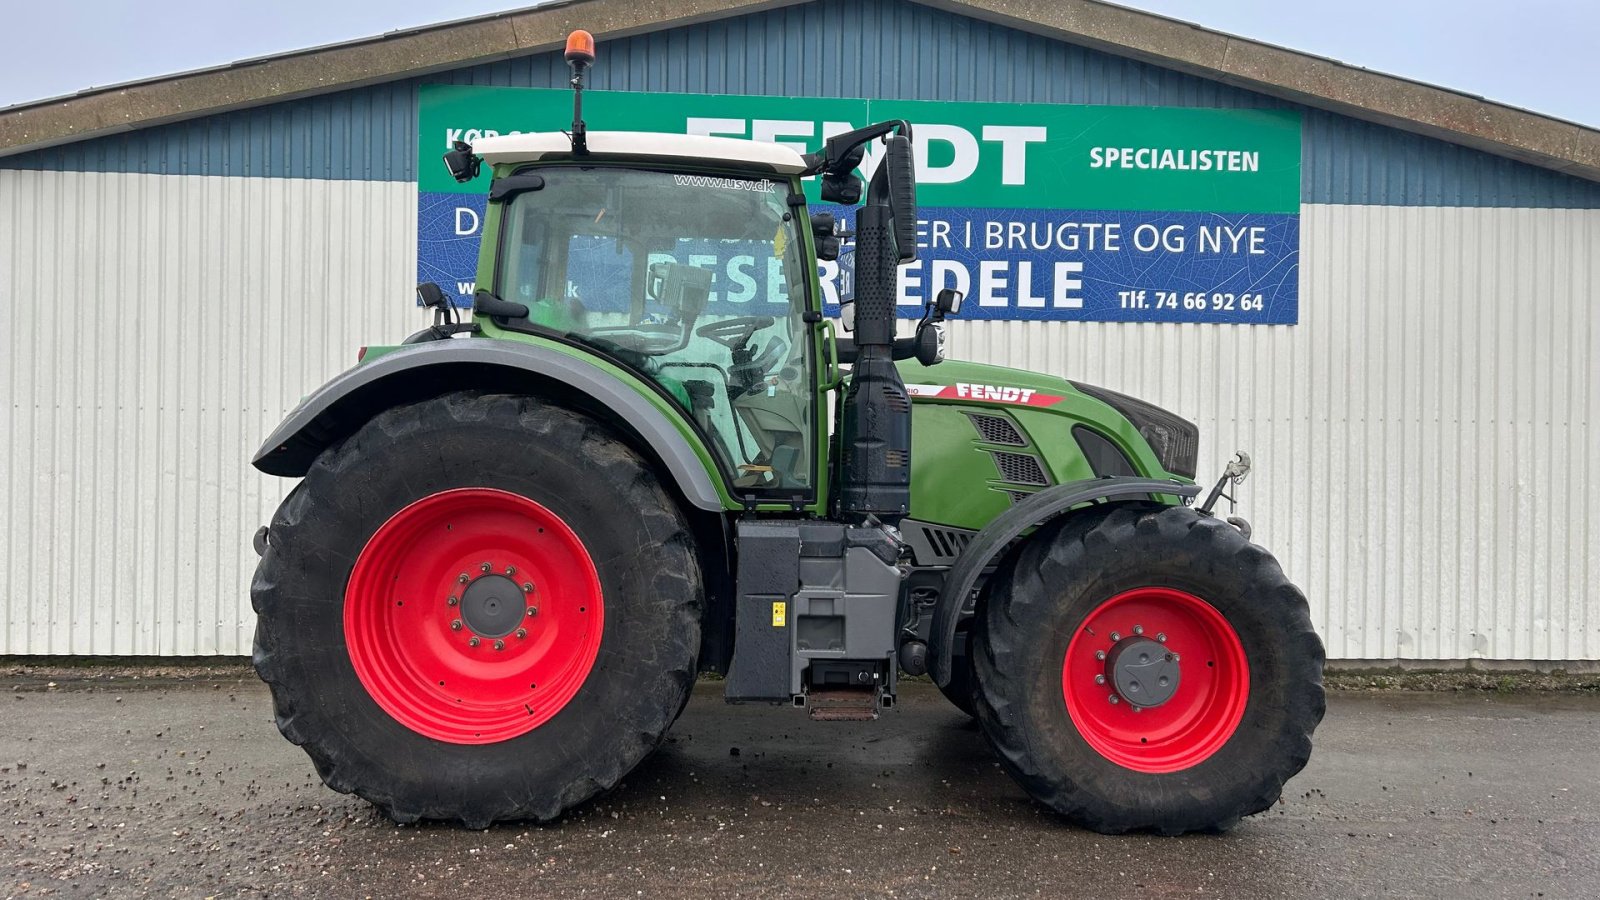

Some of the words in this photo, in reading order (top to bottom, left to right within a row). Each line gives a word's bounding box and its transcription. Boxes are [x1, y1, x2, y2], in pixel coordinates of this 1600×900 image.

[1090, 146, 1259, 172] SPECIALISTEN
[674, 174, 775, 193] www.usv.dk
[965, 221, 971, 248] I
[985, 222, 1121, 251] BRUGTE
[1133, 224, 1185, 253] OG
[1199, 226, 1266, 254] NYE
[1118, 291, 1150, 309] Tlf.
[1155, 292, 1178, 309] 74
[1183, 293, 1207, 310] 66
[1212, 293, 1235, 311] 92
[1240, 294, 1264, 311] 64
[956, 382, 1037, 403] FENDT
